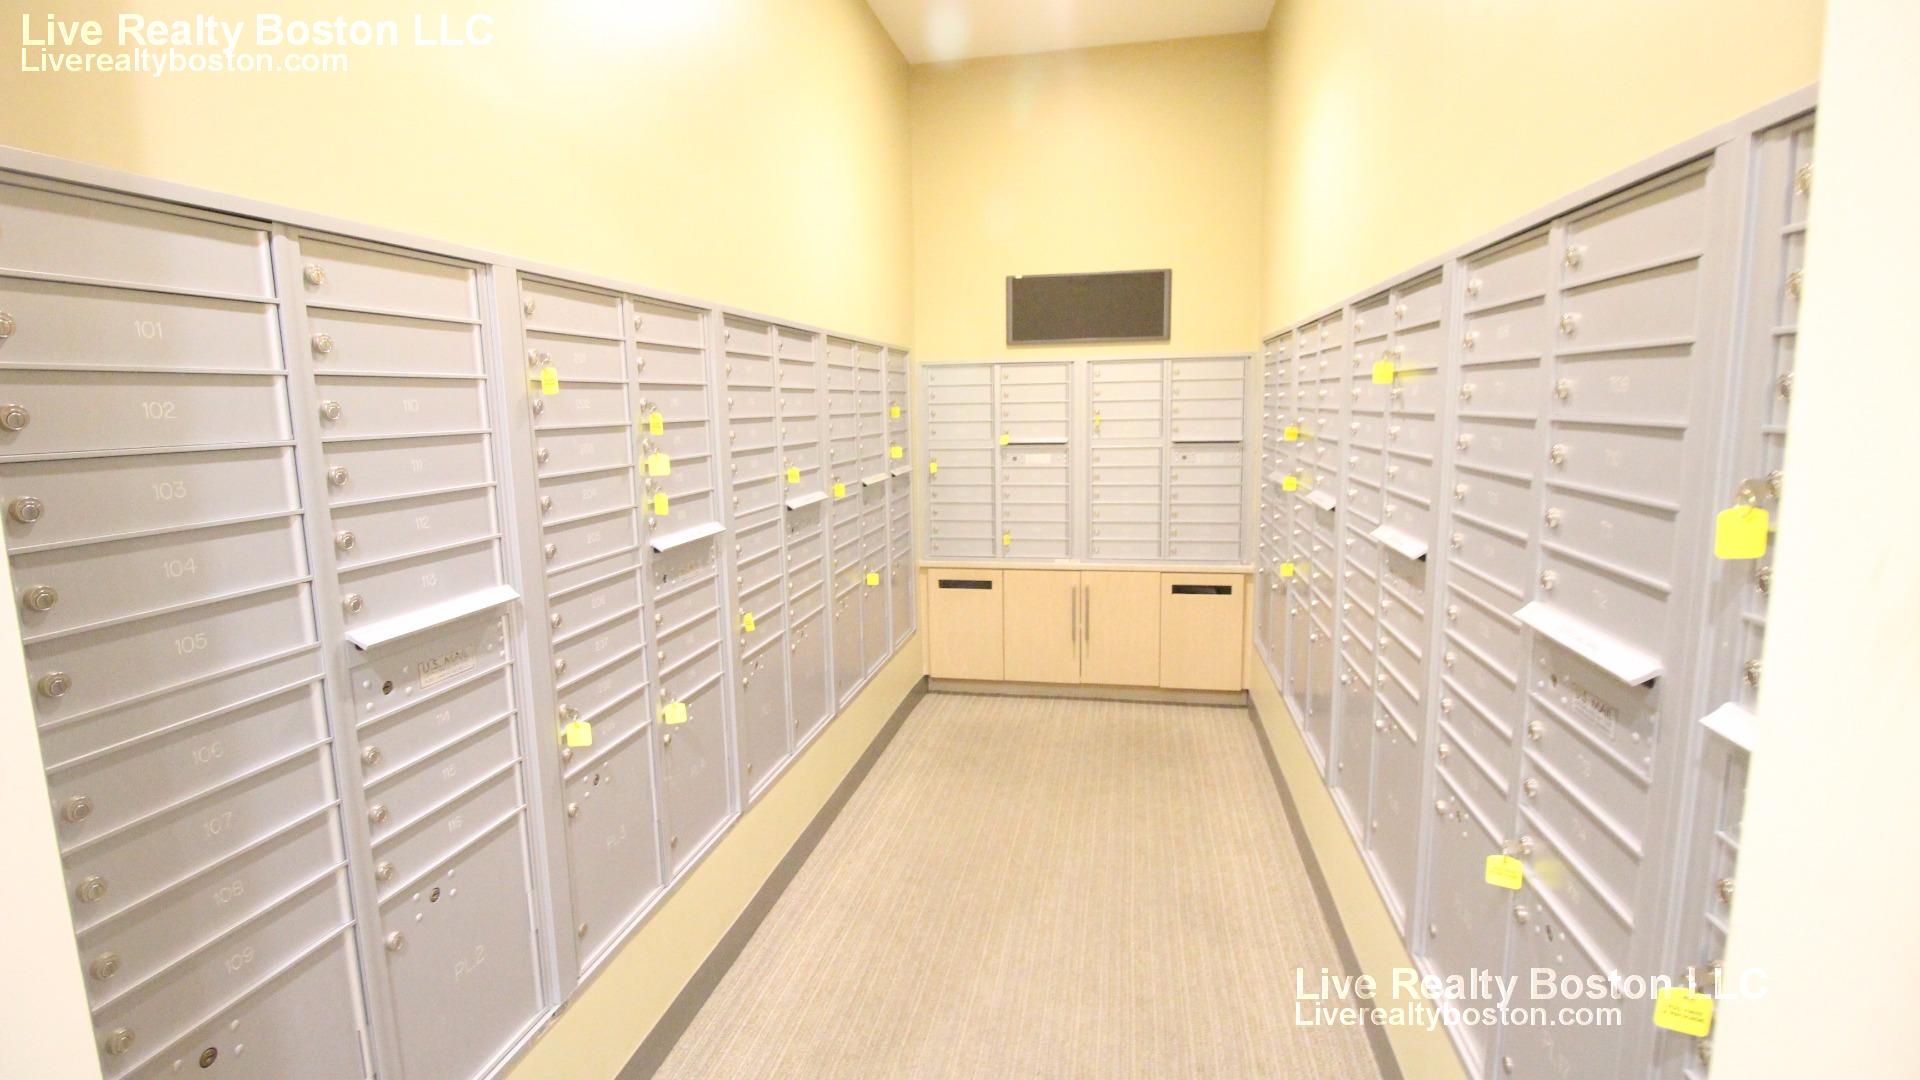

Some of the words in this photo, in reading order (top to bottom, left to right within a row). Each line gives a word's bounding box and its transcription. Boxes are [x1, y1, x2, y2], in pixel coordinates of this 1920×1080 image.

[134, 319, 164, 340] 101
[142, 400, 177, 421] 102
[402, 399, 419, 413] 110
[411, 457, 424, 472] 111
[152, 480, 187, 502] 103
[415, 515, 432, 530] 112
[162, 557, 198, 579] 104
[174, 633, 208, 656] 105
[192, 741, 225, 766] 106
[203, 812, 233, 838] 107
[212, 880, 245, 907] 108
[226, 947, 256, 974] 109
